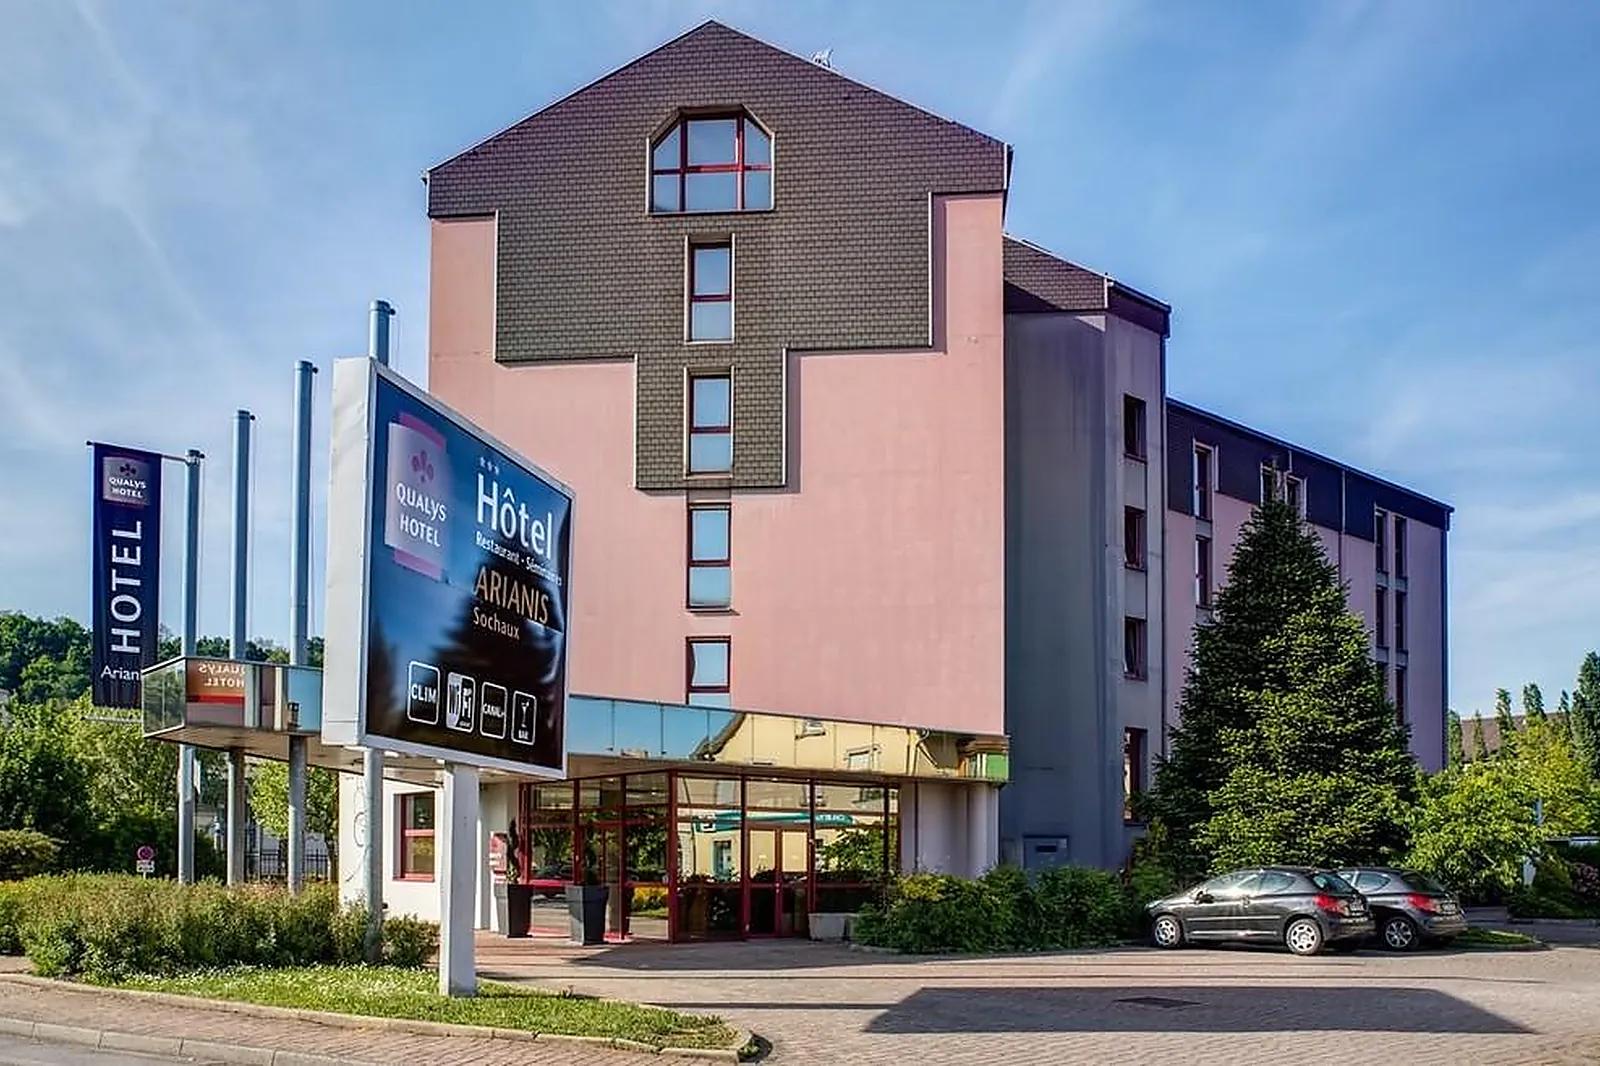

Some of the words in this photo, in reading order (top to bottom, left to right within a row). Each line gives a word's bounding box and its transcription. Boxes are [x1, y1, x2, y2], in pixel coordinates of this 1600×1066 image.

[109, 477, 147, 489] QUALYS
[112, 487, 143, 498] HOTEL
[396, 483, 447, 522] QUALYS
[477, 473, 552, 559] Hôtel
[400, 515, 441, 547] HOTEL
[476, 531, 519, 565] Restaurant
[111, 520, 142, 654] HOTEL
[472, 566, 549, 624] ARIANIS
[473, 607, 520, 640] Sochaux
[100, 665, 140, 681] Arian
[411, 684, 437, 704] CLIM
